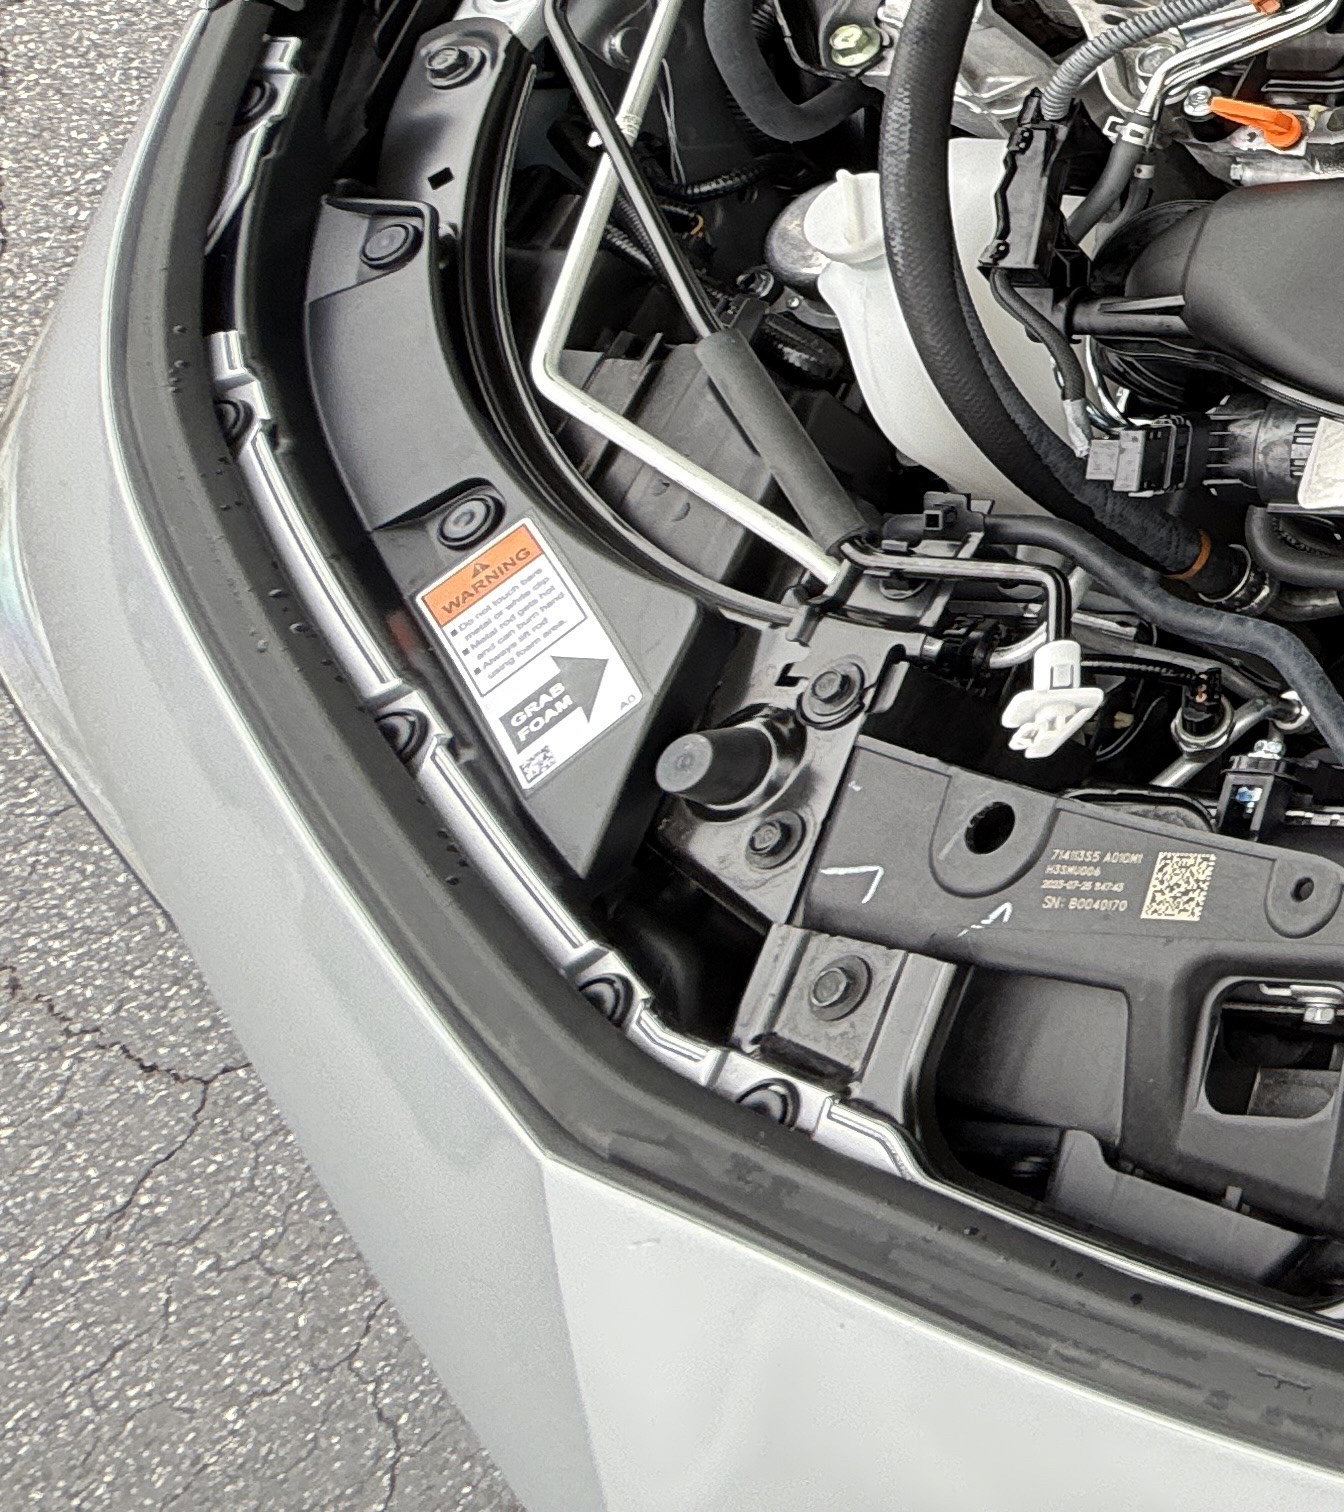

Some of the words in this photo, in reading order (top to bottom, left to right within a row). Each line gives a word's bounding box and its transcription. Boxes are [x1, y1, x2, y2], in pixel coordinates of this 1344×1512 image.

[440, 547, 532, 615] WARNING
[458, 617, 473, 630] Do
[475, 605, 491, 618] not
[492, 584, 519, 605] touch
[464, 618, 491, 640] metal
[505, 590, 530, 609] white
[470, 628, 497, 649] Metal
[499, 615, 515, 628] rod
[517, 598, 538, 616] gets
[539, 585, 555, 598] hot
[476, 643, 495, 659] and
[497, 629, 515, 644] can
[516, 611, 538, 629] burn
[481, 641, 517, 669] Always
[518, 631, 530, 641] lift
[531, 617, 548, 631] rod
[487, 657, 515, 679] using
[516, 637, 540, 656] foam
[510, 681, 566, 727] GRAB
[517, 696, 573, 743] FOAM
[1041, 896, 1065, 909] SN:
